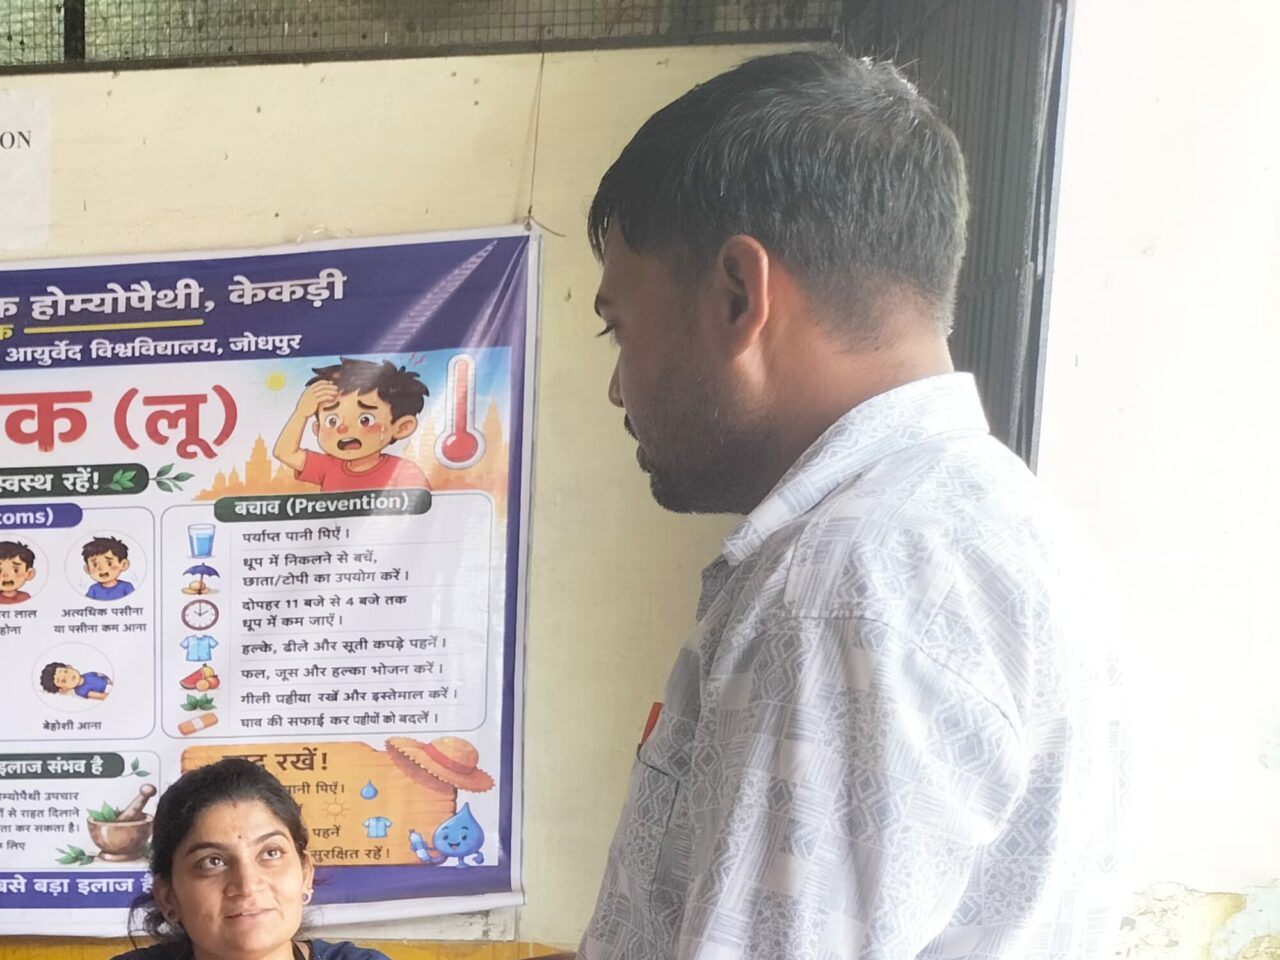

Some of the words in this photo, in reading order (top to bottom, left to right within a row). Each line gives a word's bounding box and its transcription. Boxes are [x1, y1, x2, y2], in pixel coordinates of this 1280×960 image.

[30, 279, 215, 320] होम्योपैथी,
[228, 268, 347, 309] केकड़ी
[5, 340, 82, 366] आयुर्वेद
[90, 336, 223, 360] विश्वविद्यालय,
[229, 331, 302, 355] जोधपुर
[113, 384, 238, 460] (लू)
[62, 467, 99, 492] रहें!
[234, 500, 280, 516] बचाव
[286, 492, 408, 516] (Prevention)
[242, 530, 280, 543] पर्याप्त
[286, 528, 312, 541] पानी
[242, 556, 264, 570] धूप
[268, 554, 280, 566] में
[284, 551, 332, 566] निकलने
[337, 551, 348, 564] से
[314, 573, 330, 584] का
[335, 569, 376, 582] उपयोग
[242, 598, 280, 611] दोपहर
[286, 600, 298, 608] 11
[304, 594, 324, 608] बजे
[330, 594, 340, 607] से
[346, 597, 354, 606] 4
[359, 593, 380, 606] बजे
[385, 595, 407, 606] तक
[14, 610, 38, 619] लाल
[61, 606, 108, 618] अत्यधिक
[110, 604, 144, 616] पसीना
[0, 624, 22, 636] होना
[54, 624, 66, 634] या
[69, 622, 98, 633] पसीना
[101, 623, 119, 632] कम
[122, 622, 146, 632] आना
[242, 618, 262, 631] धूप
[266, 615, 278, 628] में
[281, 616, 304, 626] कम
[282, 640, 308, 652] ढीले
[313, 638, 337, 652] और
[342, 638, 368, 653] सूती
[372, 636, 404, 651] कपड़े
[275, 668, 298, 682] जूस
[303, 664, 326, 677] और
[332, 666, 366, 678] हल्का
[370, 662, 408, 676] भोजन
[241, 692, 270, 704] गीली
[318, 690, 338, 702] रखें
[344, 689, 366, 701] और
[371, 688, 424, 702] इस्तेमाल
[42, 718, 74, 732] बेहोशी
[78, 721, 102, 730] आना
[267, 715, 282, 727] की
[287, 713, 324, 728] सफाई
[330, 716, 350, 726] कर
[383, 712, 396, 724] को
[47, 756, 86, 774] संभव
[90, 755, 104, 774] है
[275, 747, 328, 771] रखें!
[312, 824, 340, 838] पहनें
[311, 846, 360, 863] सुरक्षित
[34, 878, 70, 897] बड़ा
[76, 878, 135, 895] इलाज
